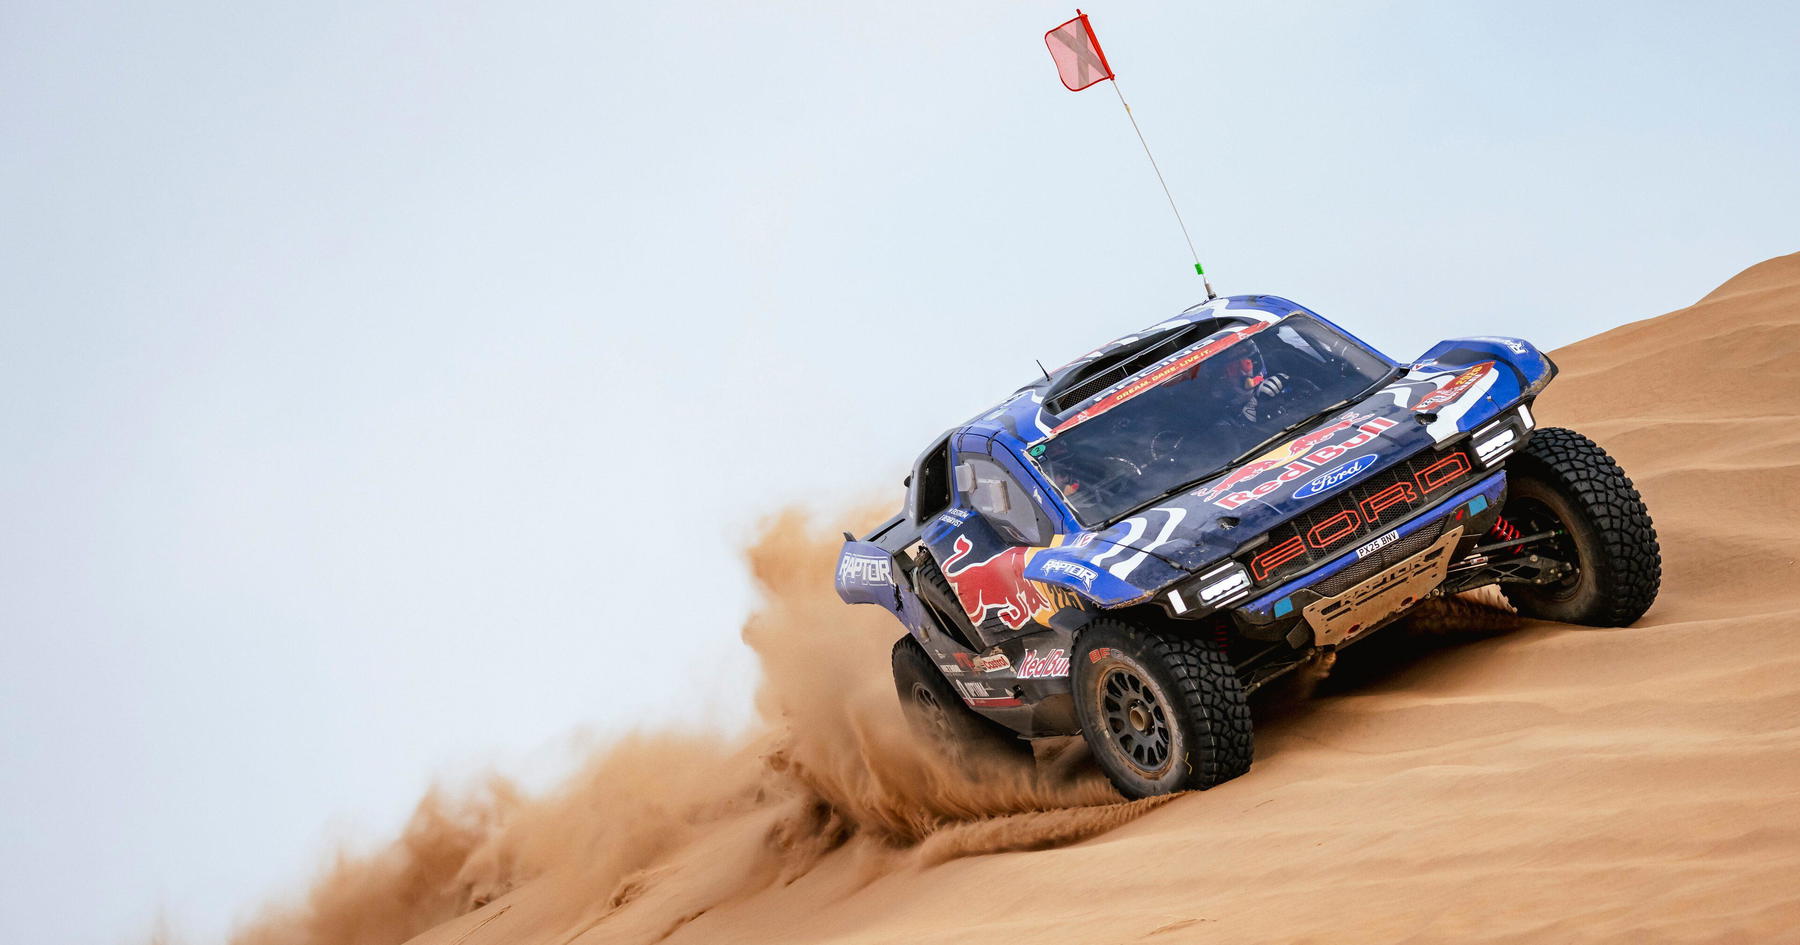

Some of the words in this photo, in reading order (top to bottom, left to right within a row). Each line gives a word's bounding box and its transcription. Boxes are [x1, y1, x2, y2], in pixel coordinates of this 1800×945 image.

[1213, 461, 1315, 511] Red
[1305, 416, 1400, 467] Bull
[1310, 460, 1363, 493] Ford
[1251, 452, 1472, 582] FORD
[1358, 540, 1381, 557] PX25
[1381, 531, 1399, 545] BNV
[838, 553, 897, 590] RAPTOR
[1040, 558, 1099, 593] RAPTOR
[983, 656, 1010, 670] Castrol
[1016, 648, 1052, 679] Red
